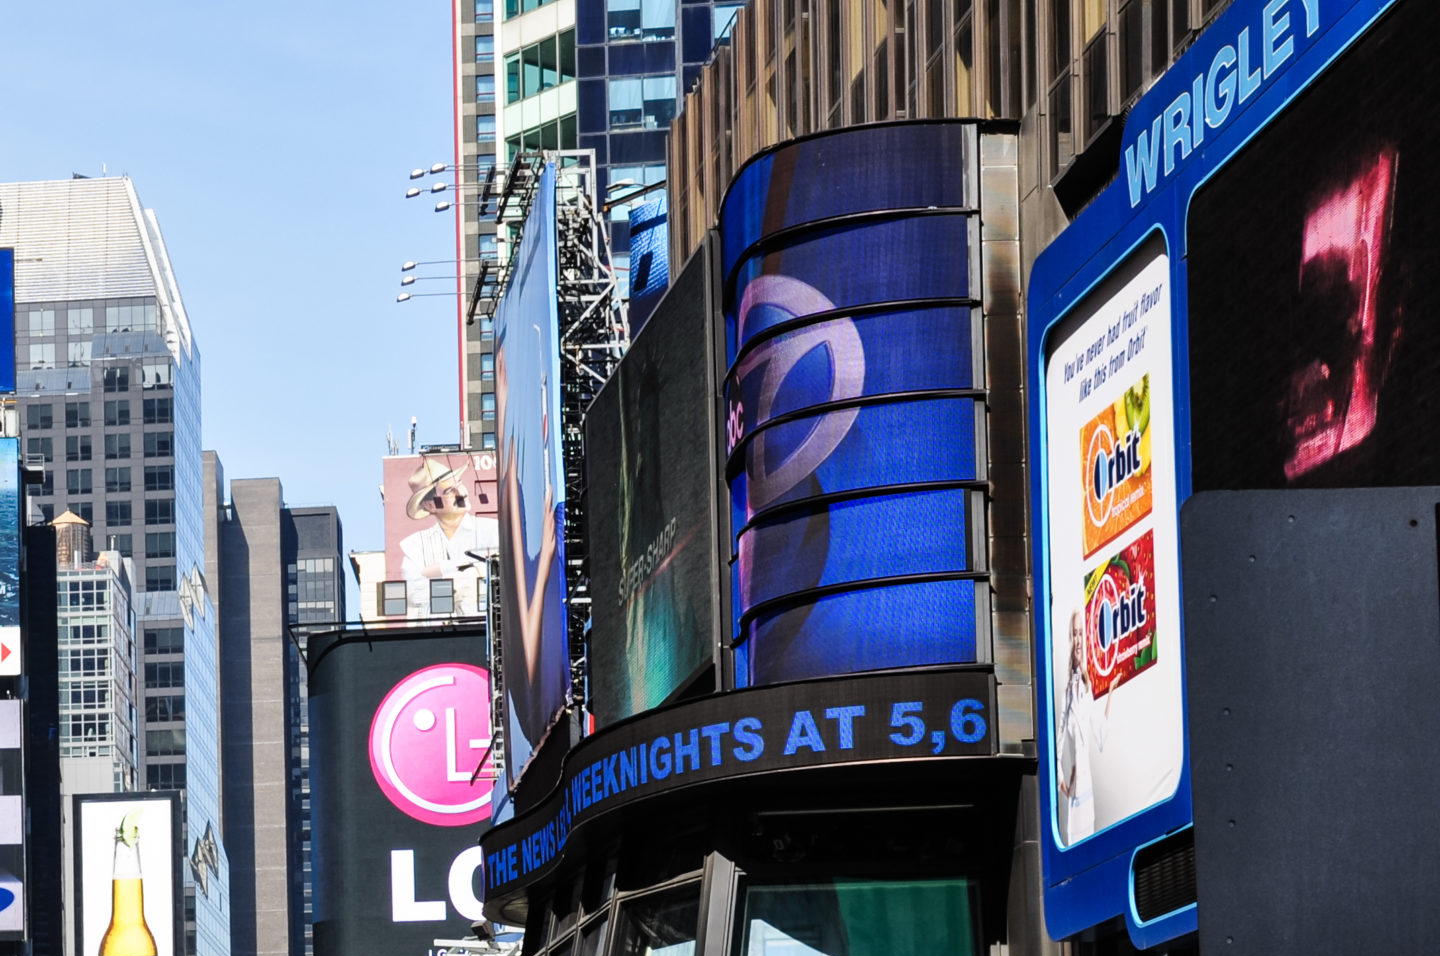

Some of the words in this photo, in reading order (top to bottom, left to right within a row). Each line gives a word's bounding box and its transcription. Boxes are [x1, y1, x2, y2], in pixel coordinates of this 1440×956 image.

[1086, 335, 1106, 366] never
[1107, 316, 1121, 347] had
[1122, 301, 1139, 334] fruit
[1079, 378, 1092, 403] like
[1094, 363, 1107, 390] this
[1109, 350, 1126, 378] from
[487, 843, 518, 889] THE
[522, 820, 556, 875] NEWS
[571, 716, 765, 817] WEEKNIGHTS
[783, 705, 866, 756] AT
[889, 698, 988, 756] 5,6
